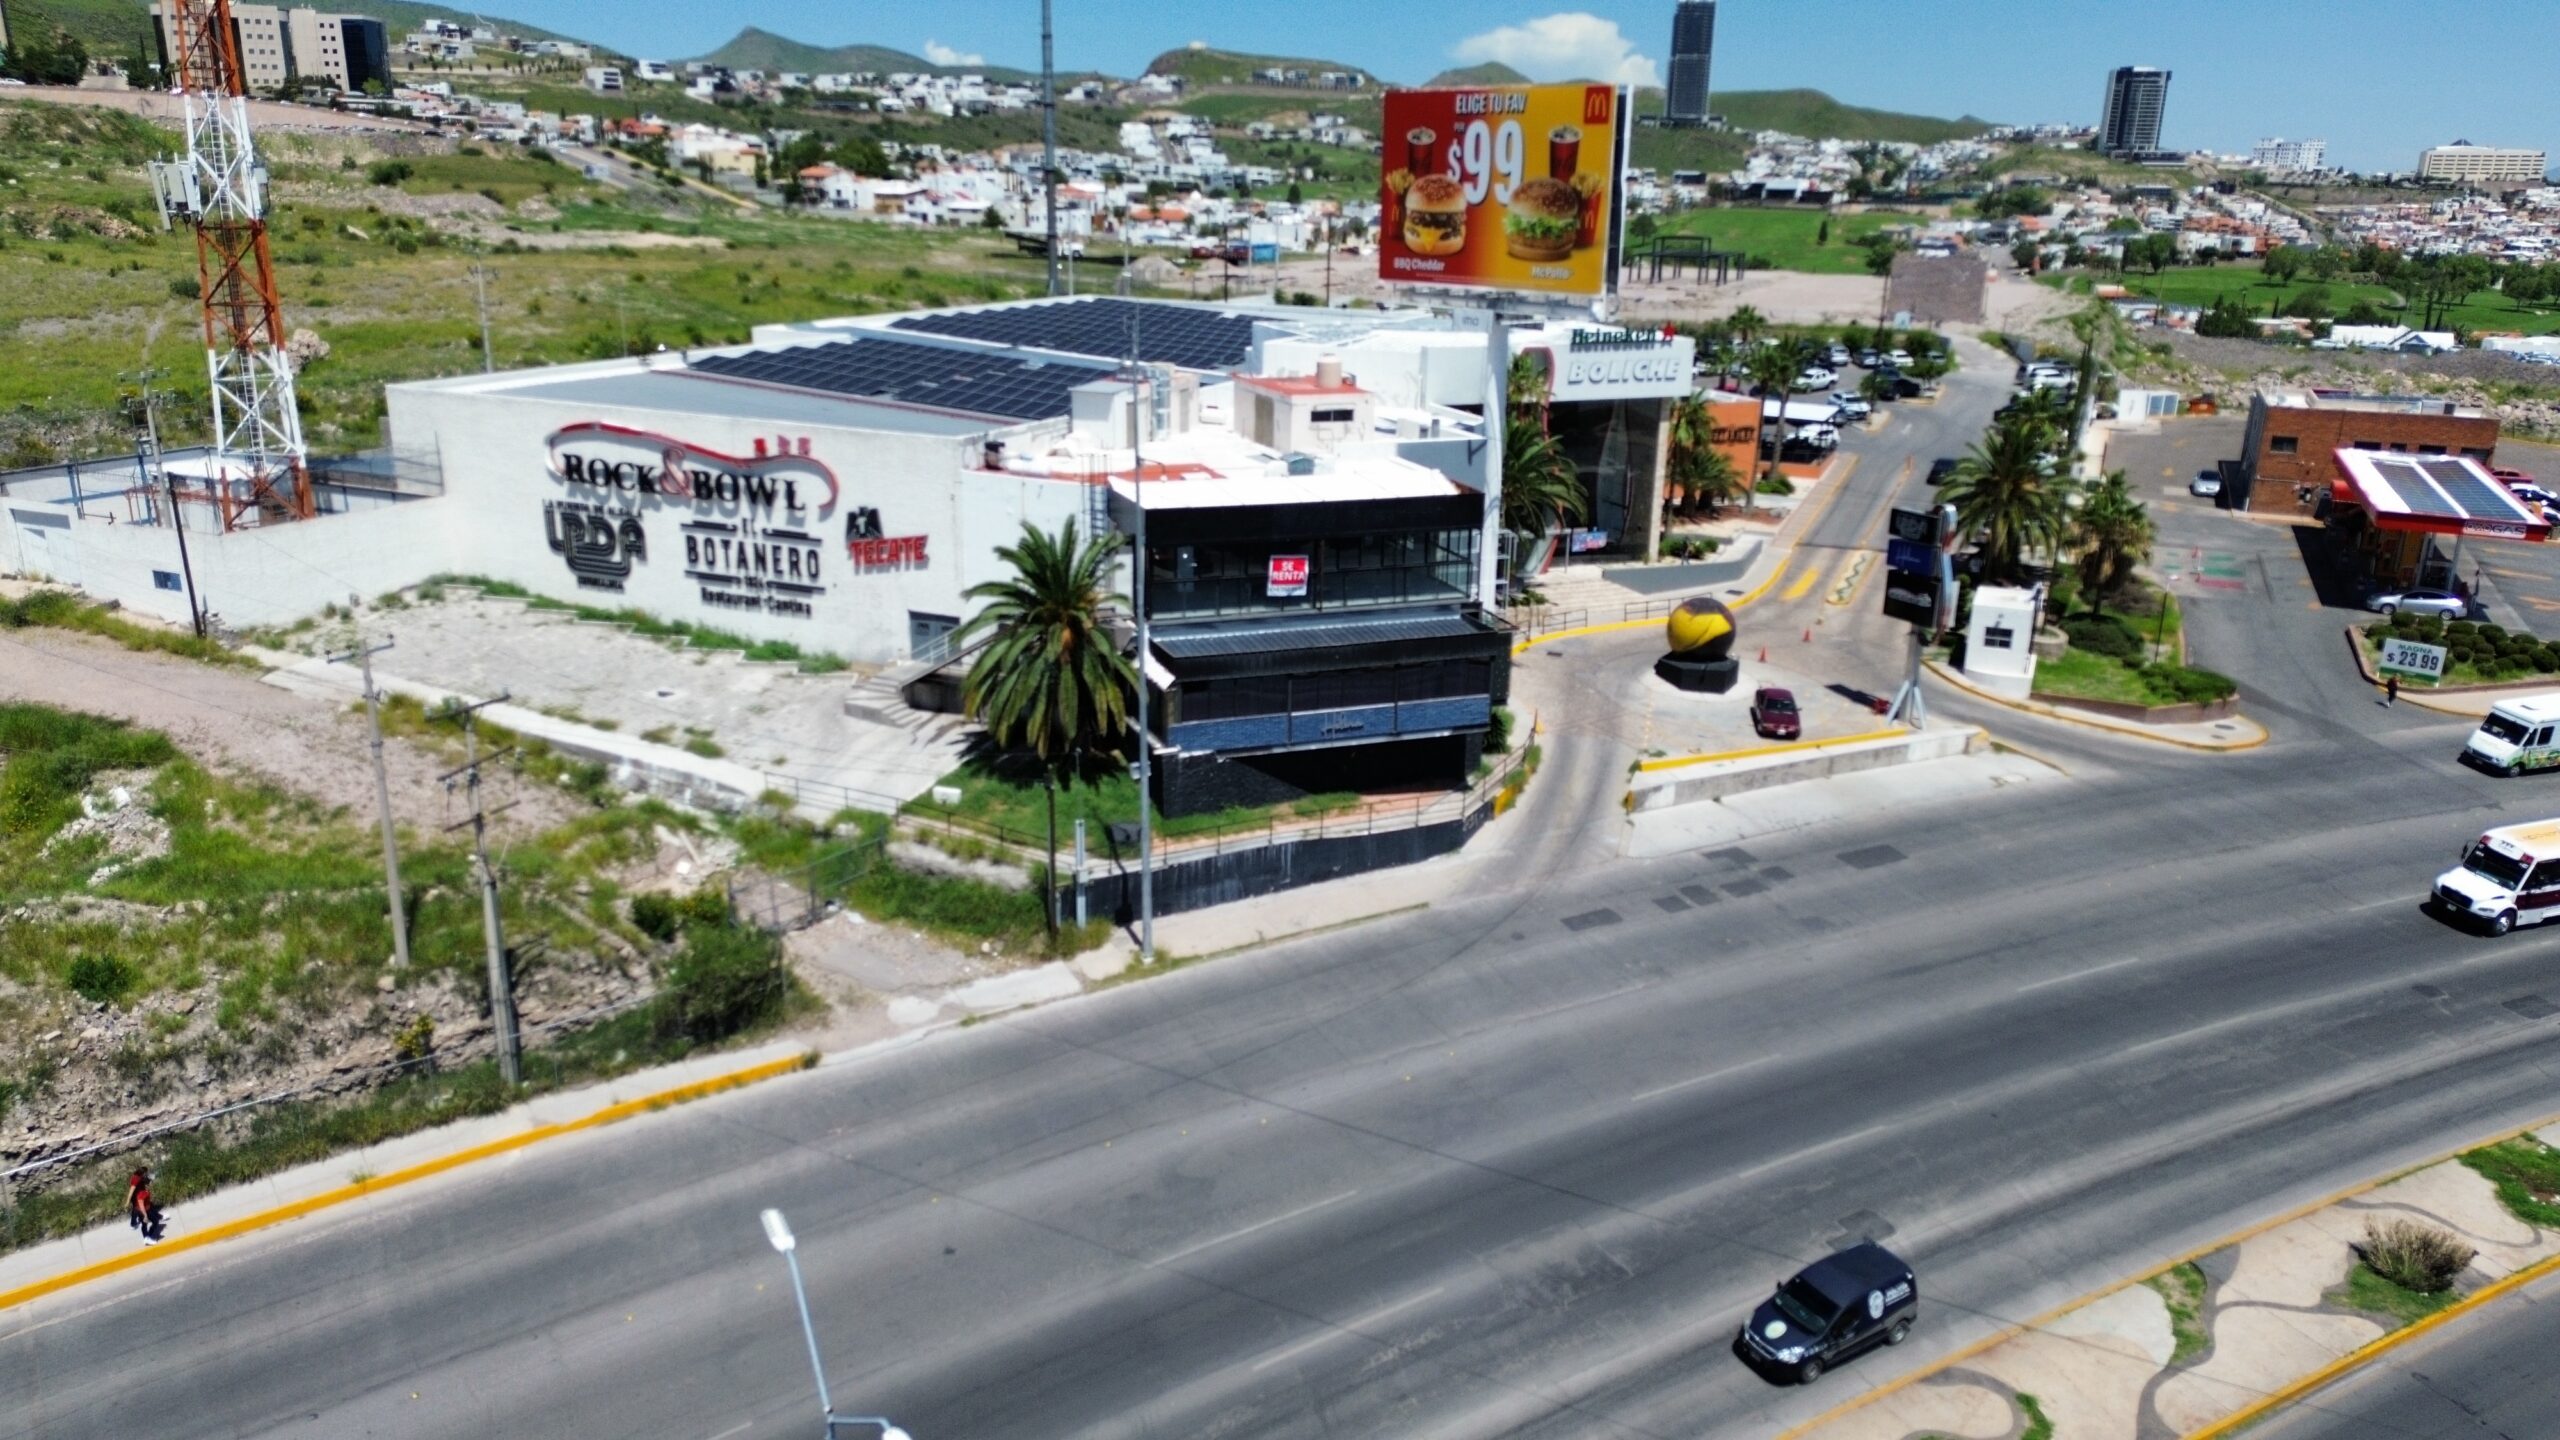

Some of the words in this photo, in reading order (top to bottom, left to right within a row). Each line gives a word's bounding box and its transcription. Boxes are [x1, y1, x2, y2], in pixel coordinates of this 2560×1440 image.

[1455, 94, 1487, 115] ELIGE
[1489, 93, 1504, 114] TU
[1506, 92, 1528, 113] FAV
[1394, 257, 1411, 271] BBQ
[1411, 259, 1446, 272] Cheddar
[1572, 327, 1657, 345] Heineken
[1568, 360, 1680, 385] BOLICHE
[563, 453, 660, 495] ROCK
[660, 447, 694, 497] &
[691, 469, 806, 511] BOWL
[742, 517, 757, 535] EL
[686, 534, 820, 579] BOTANERO
[850, 535, 928, 567] TECATE
[1282, 561, 1294, 571] SE
[1273, 570, 1304, 581] RENTA
[2398, 643, 2433, 655] MAGNA
